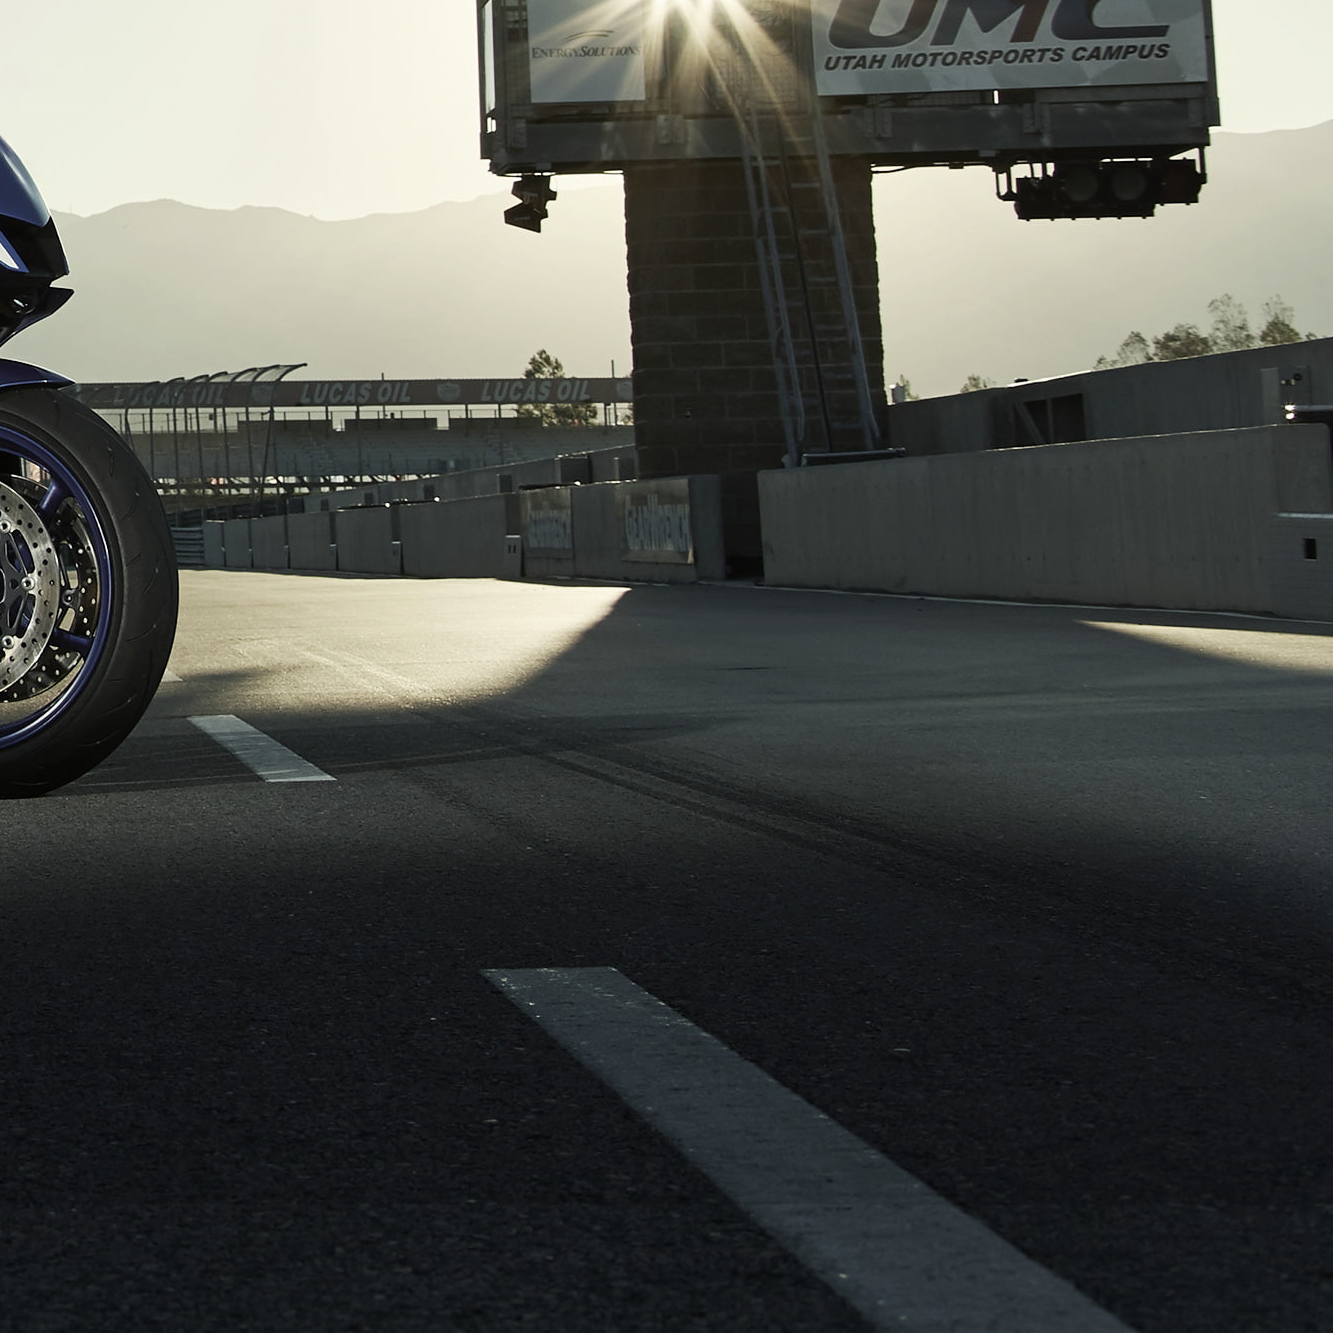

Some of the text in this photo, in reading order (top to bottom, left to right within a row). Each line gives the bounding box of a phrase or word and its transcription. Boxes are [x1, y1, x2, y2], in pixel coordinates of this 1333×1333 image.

[824, 43, 1171, 71] UTAH MOTORSPORTS CAMPUS
[191, 383, 224, 405] OIL
[300, 382, 411, 404] LUCAS OIL
[481, 379, 591, 402] LUCAS OIL
